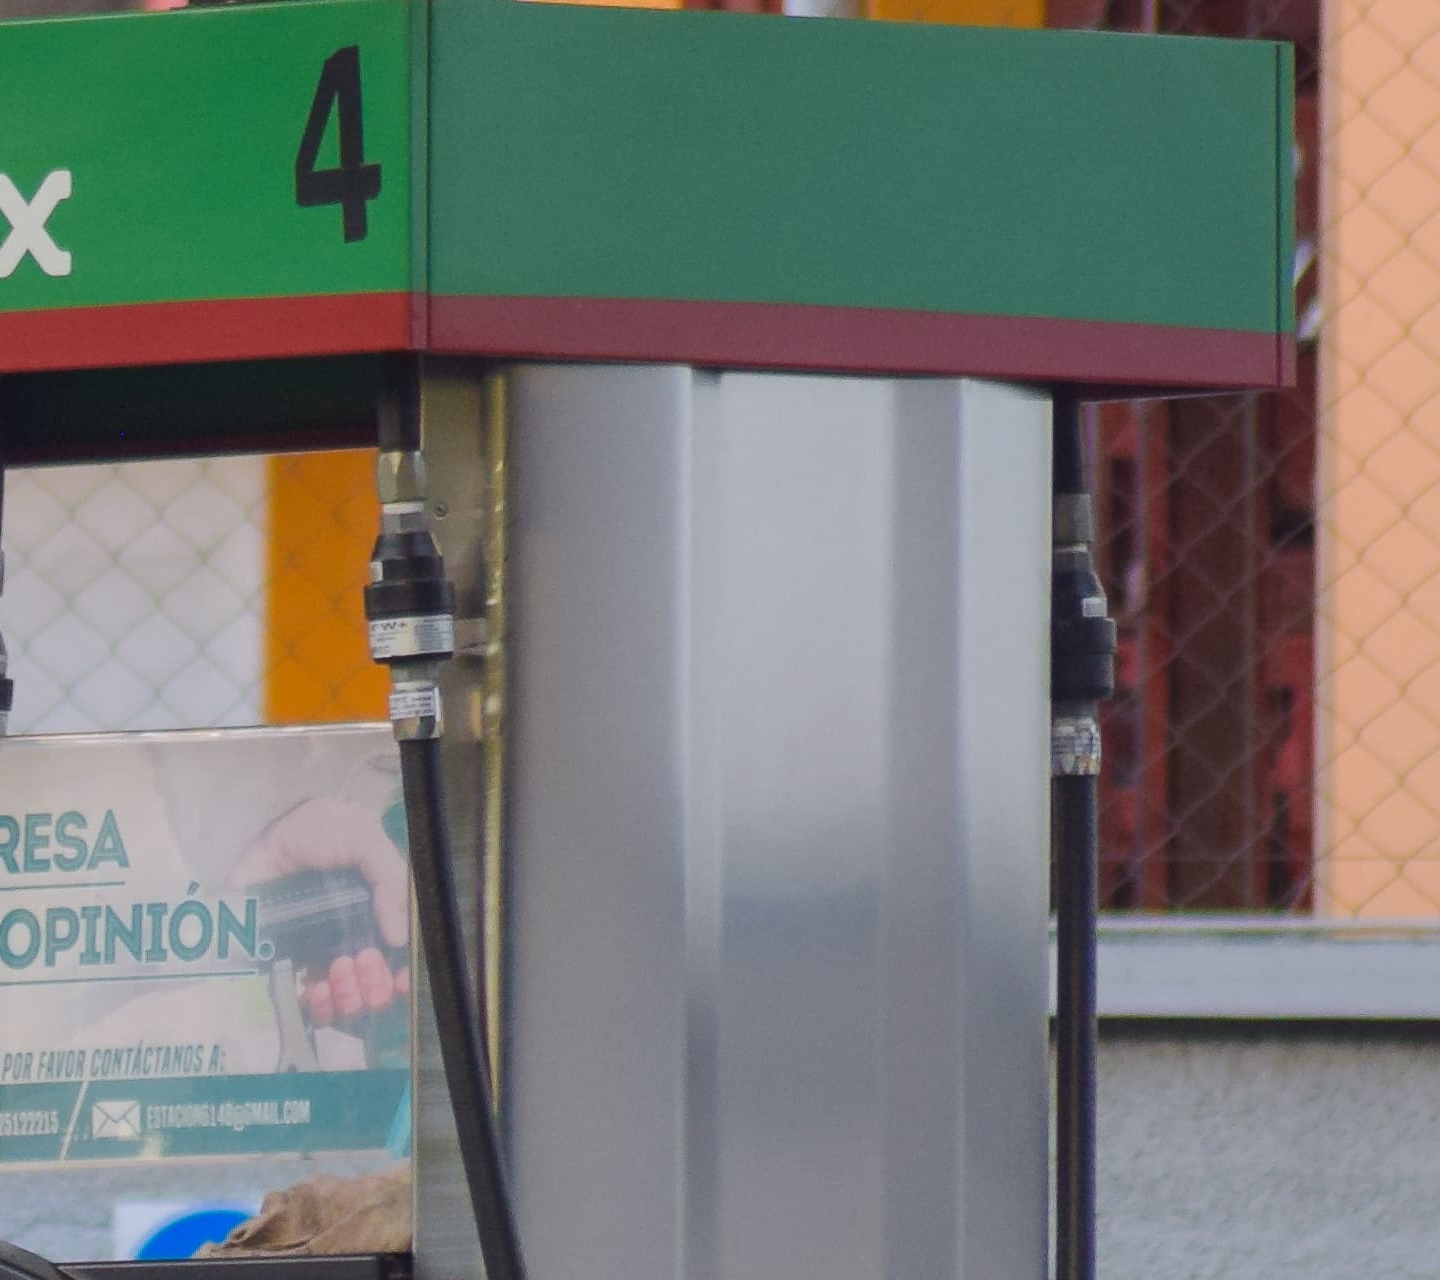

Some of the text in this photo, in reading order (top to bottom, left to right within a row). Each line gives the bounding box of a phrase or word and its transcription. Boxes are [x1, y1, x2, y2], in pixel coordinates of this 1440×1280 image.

[292, 46, 381, 244] 4
[2, 1052, 32, 1080] POR
[38, 1050, 85, 1079] FAVOR
[90, 1040, 205, 1077] CONTÁCTANOS
